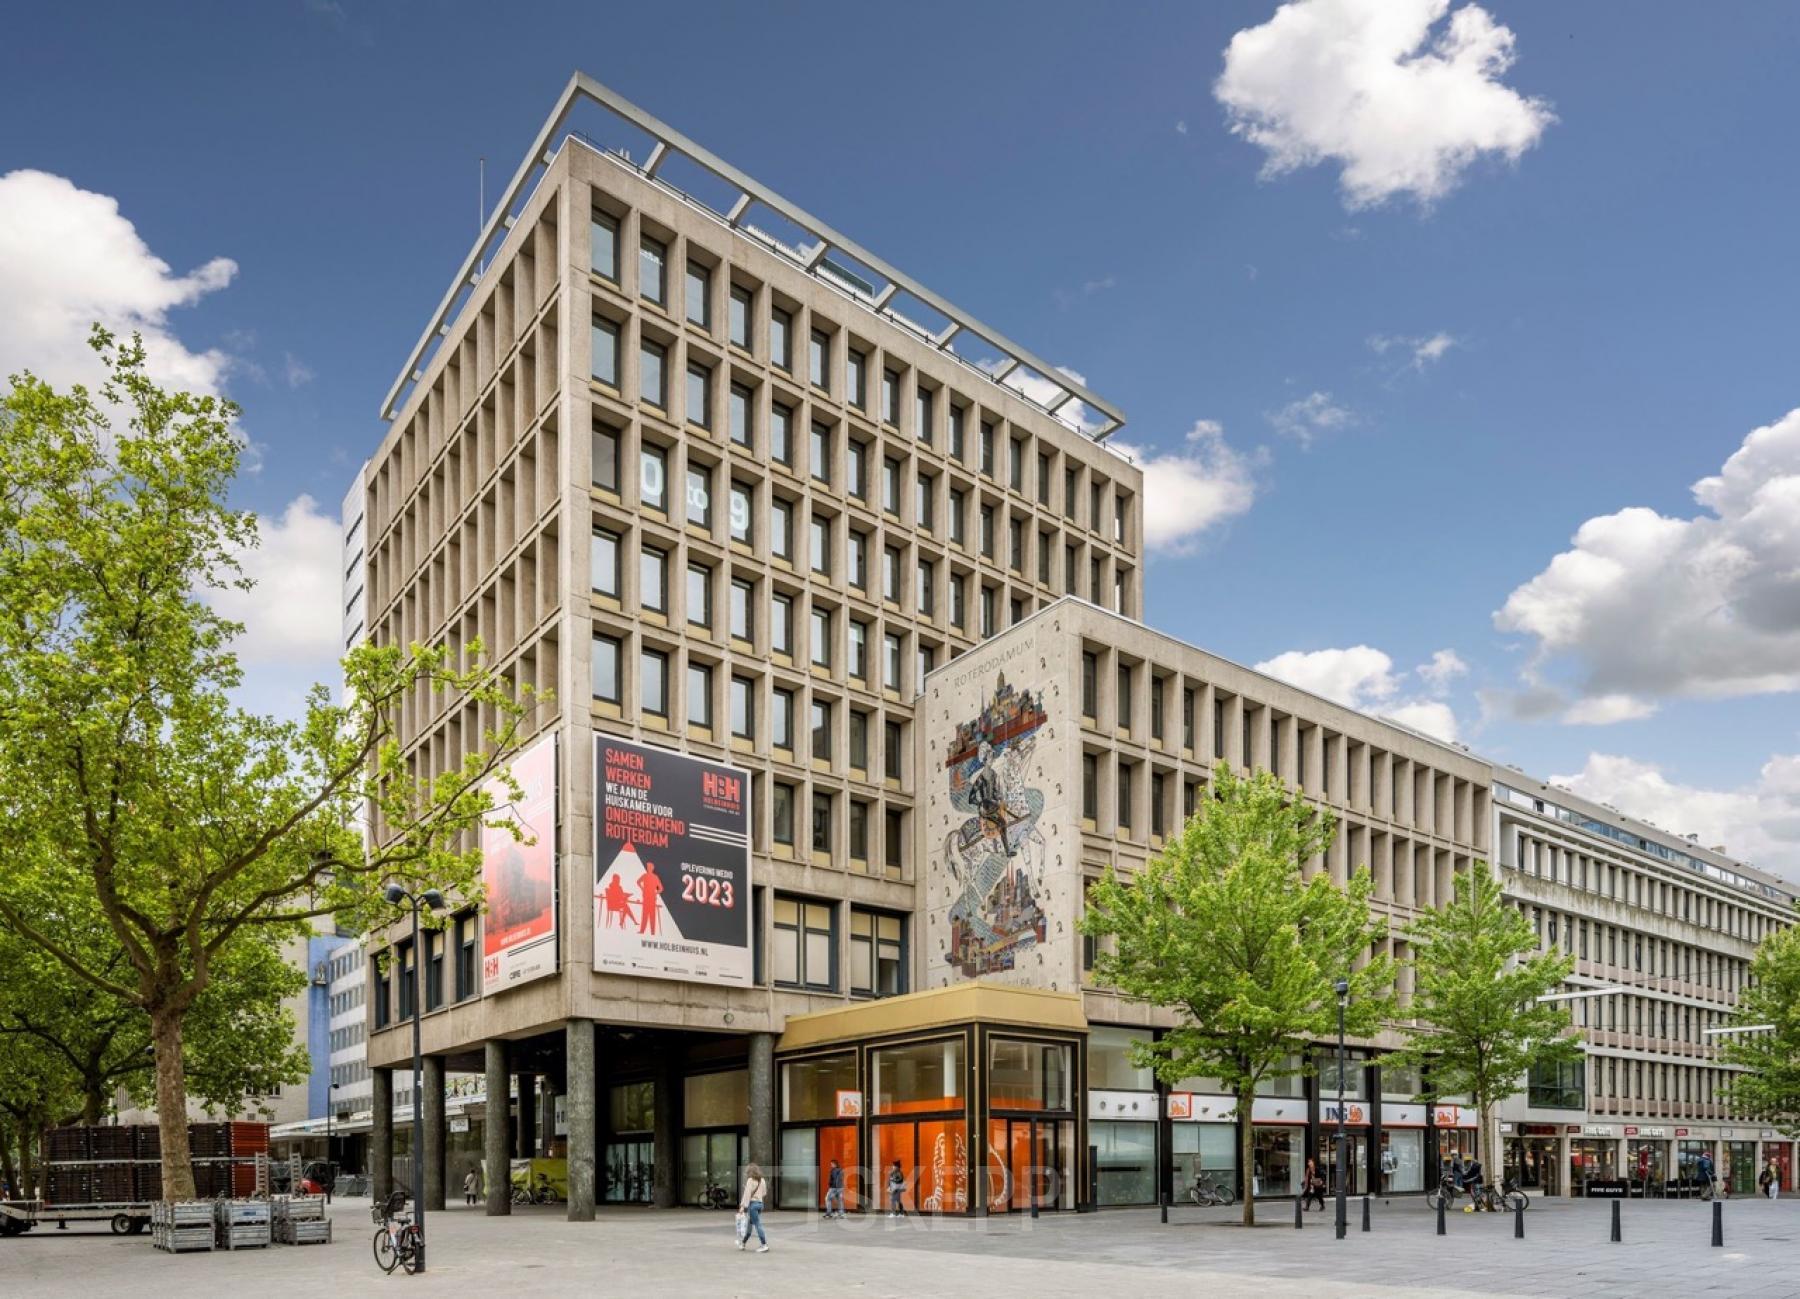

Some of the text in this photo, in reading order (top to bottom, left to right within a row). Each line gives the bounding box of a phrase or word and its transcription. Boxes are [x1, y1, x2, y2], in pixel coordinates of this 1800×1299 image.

[605, 748, 644, 770] SAMEN
[605, 766, 652, 790] WERKEN
[605, 781, 648, 801] WE AAN DE
[605, 793, 673, 818] HUISKAMER VOOR
[605, 806, 685, 836] ONDERNEMEND
[605, 822, 669, 848] ROTTERDAM
[681, 873, 734, 908] 2023
[641, 939, 709, 956] WWW.HOLBEINHUIS.NL
